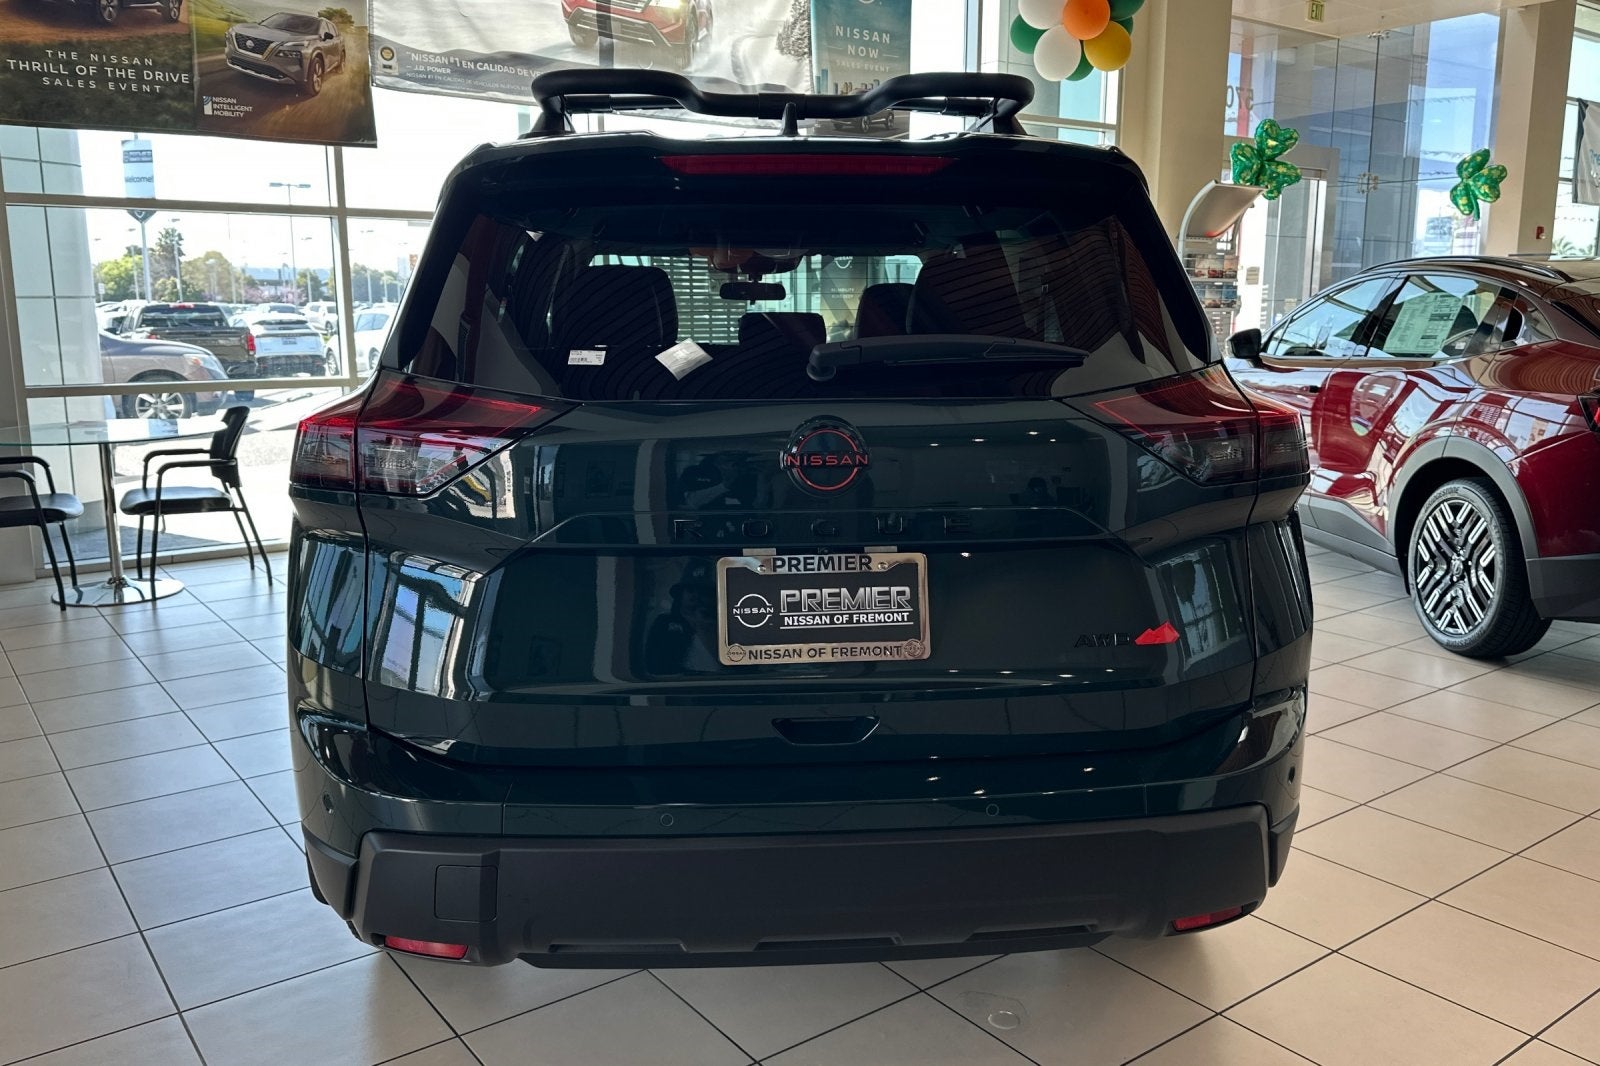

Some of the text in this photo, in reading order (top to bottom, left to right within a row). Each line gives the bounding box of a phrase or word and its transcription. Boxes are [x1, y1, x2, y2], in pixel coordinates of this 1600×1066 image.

[835, 25, 890, 44] NISSAN
[46, 49, 153, 66] THE NISSAN
[847, 44, 879, 58] NOW
[6, 59, 191, 84] THRILL OF THE DRIVE
[450, 56, 460, 67] #1
[462, 60, 474, 70] EN
[476, 62, 515, 74] CALIDAD
[517, 68, 529, 77] DE
[42, 77, 162, 93] SALES EVENT
[212, 96, 237, 104] NISSAN
[212, 103, 253, 112] INTELLIGENT
[213, 110, 244, 118] MOBILITY
[786, 454, 868, 466] NISSAN
[673, 514, 971, 542] ROGUE
[771, 555, 872, 573] PREMIER
[780, 586, 912, 612] PREMIER
[784, 612, 910, 626] NISSAN OF FREMONT
[1073, 633, 1130, 648] AWD
[748, 648, 802, 660] NISSAN
[807, 647, 827, 658] OF
[831, 645, 902, 657] FREMONT
